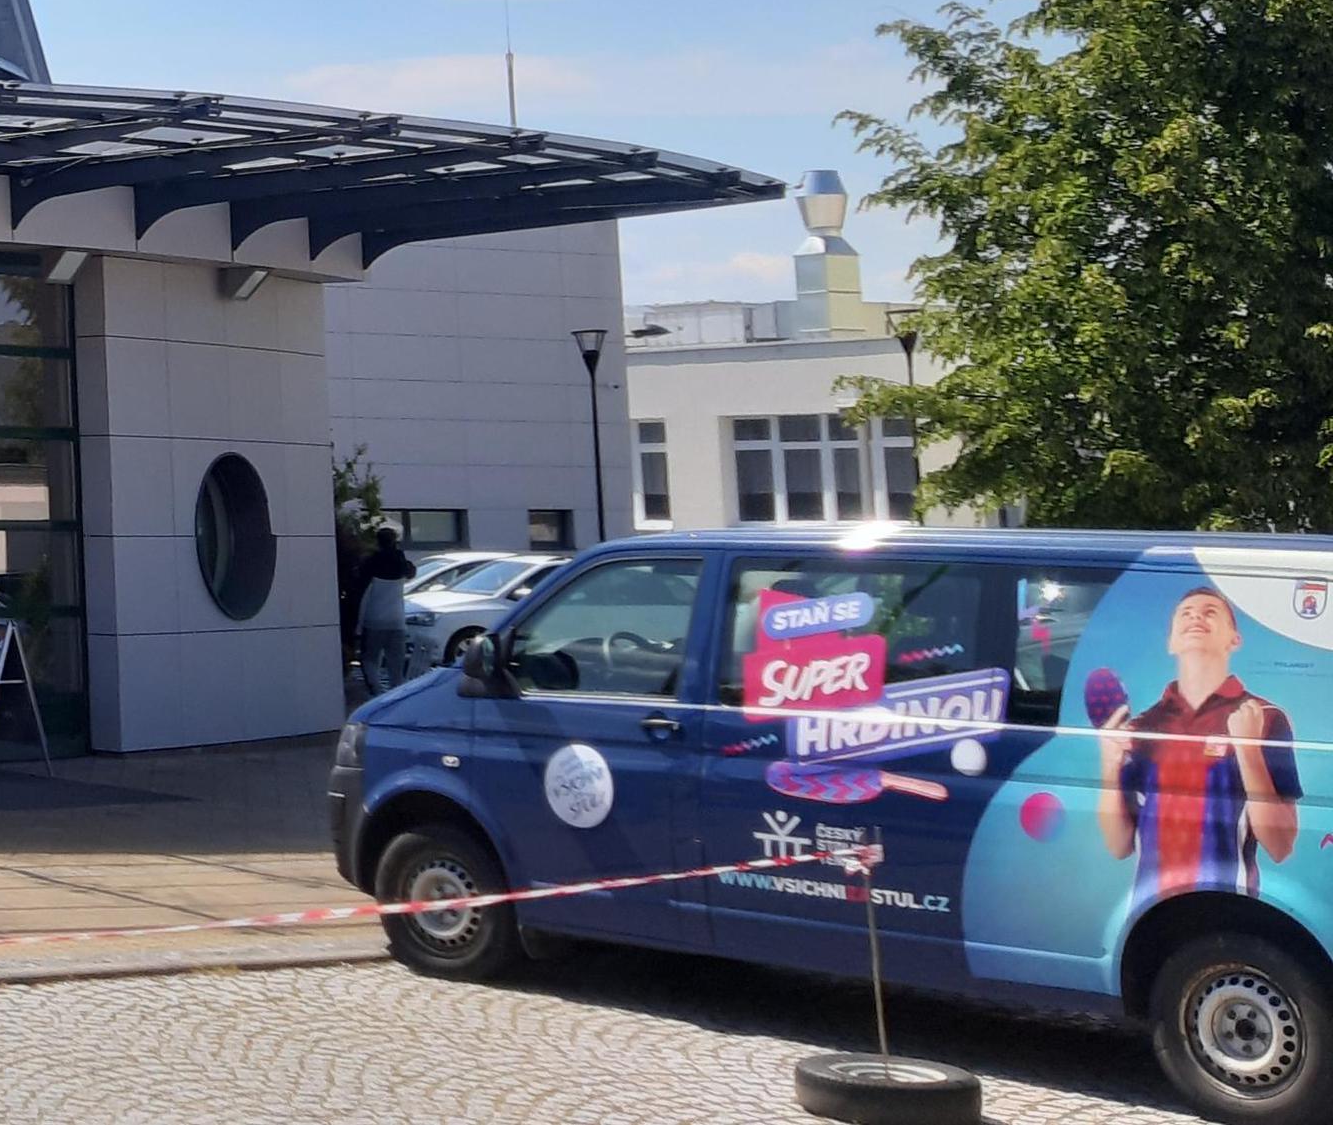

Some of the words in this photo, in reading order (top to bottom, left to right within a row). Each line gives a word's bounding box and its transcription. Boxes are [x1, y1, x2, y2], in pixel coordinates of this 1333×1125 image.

[773, 601, 829, 630] STAŇ
[833, 600, 861, 621] SE
[758, 652, 871, 707] SUPER
[816, 823, 867, 843] ČESKÝ
[718, 871, 951, 913] WWW.VSICHNISTUL.CZ
